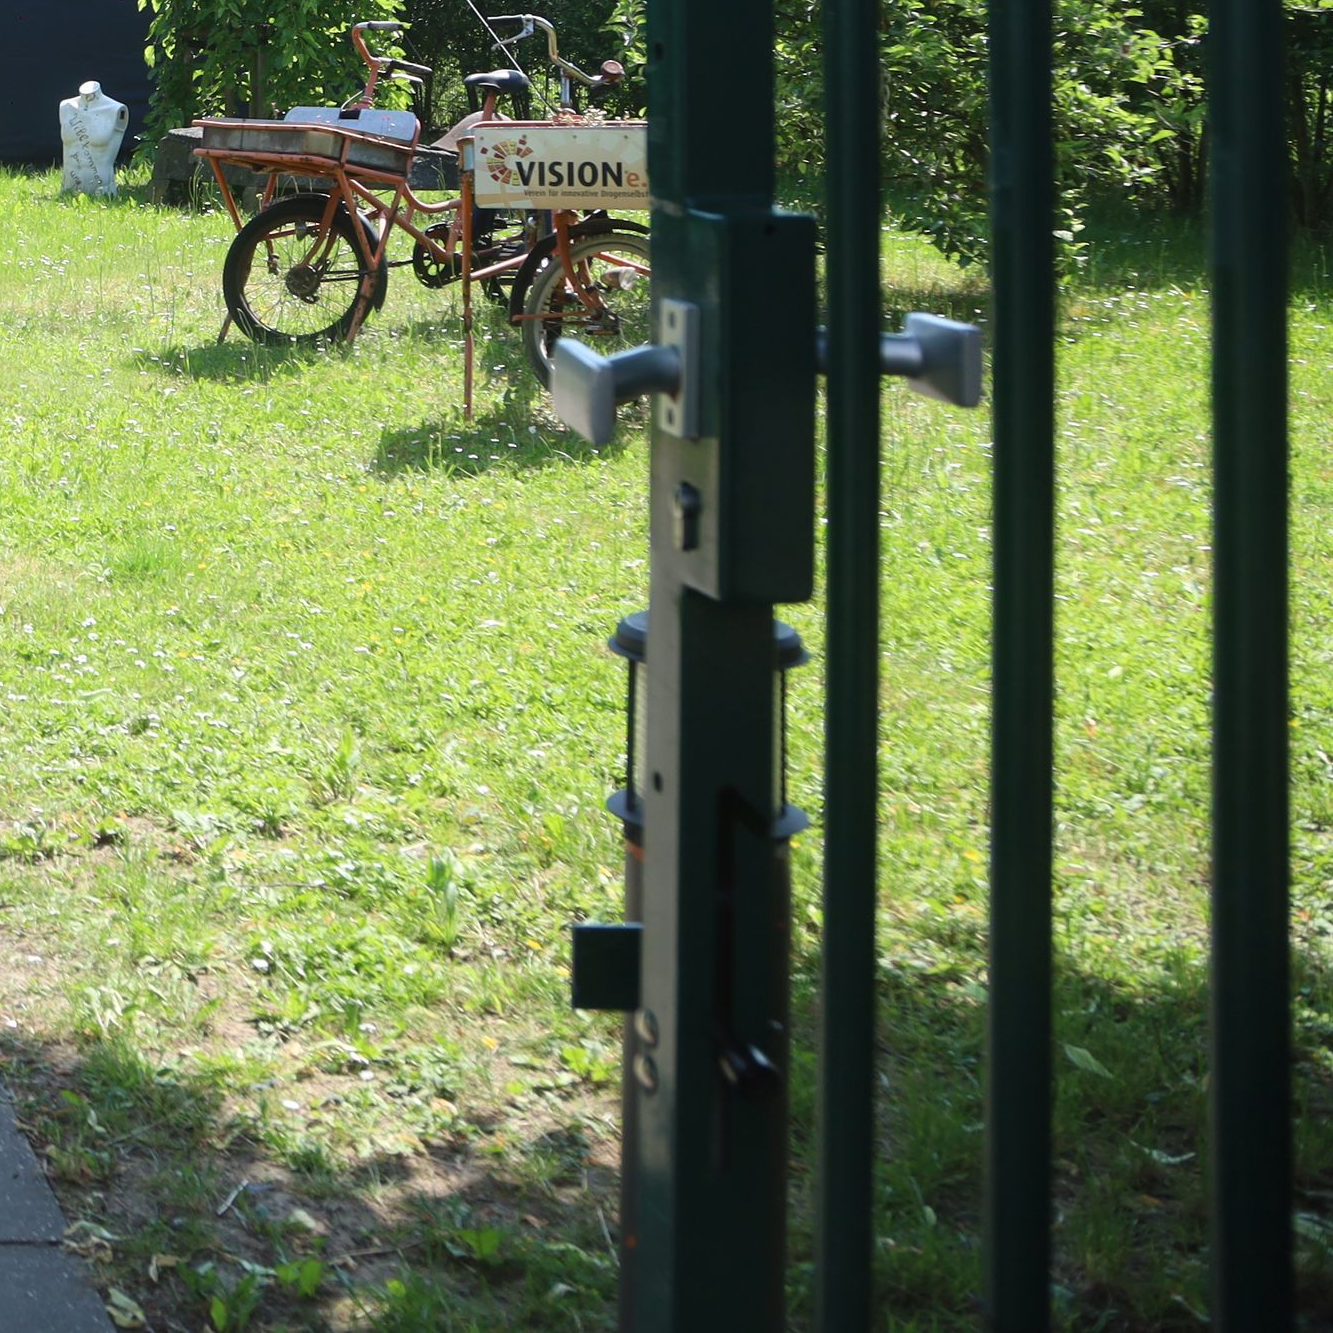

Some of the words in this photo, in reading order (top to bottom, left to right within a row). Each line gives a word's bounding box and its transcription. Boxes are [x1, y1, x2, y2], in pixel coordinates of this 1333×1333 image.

[515, 161, 623, 187] VISION
[627, 169, 649, 187] e.
[524, 189, 547, 197] Verein
[561, 189, 599, 197] innovative
